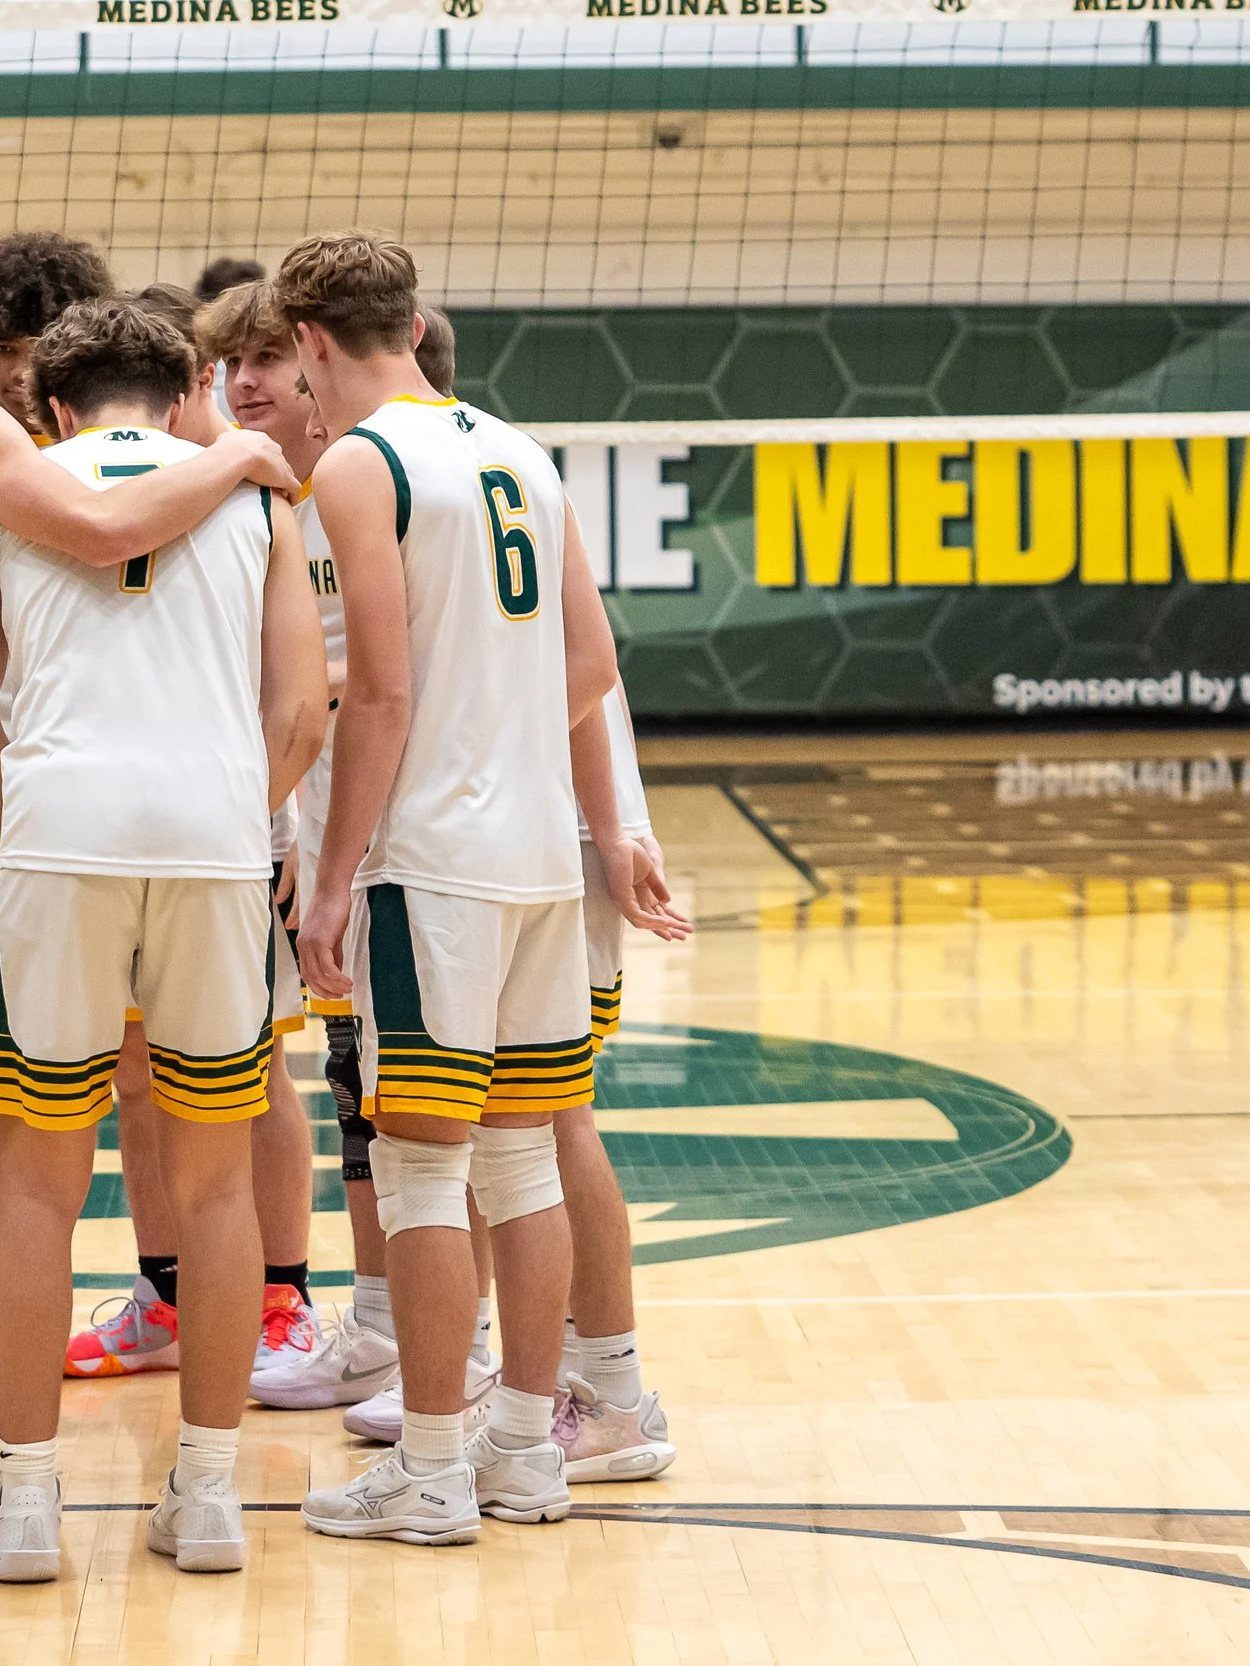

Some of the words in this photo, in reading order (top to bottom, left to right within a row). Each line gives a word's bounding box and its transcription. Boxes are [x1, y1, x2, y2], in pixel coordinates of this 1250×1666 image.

[97, 0, 239, 23] MEDINA
[251, 0, 339, 21] BEES
[587, 0, 728, 18] MEDINA
[741, 0, 827, 15] BEES
[479, 465, 541, 622] 6
[993, 672, 1183, 714] Sponsored
[1190, 670, 1235, 713] by
